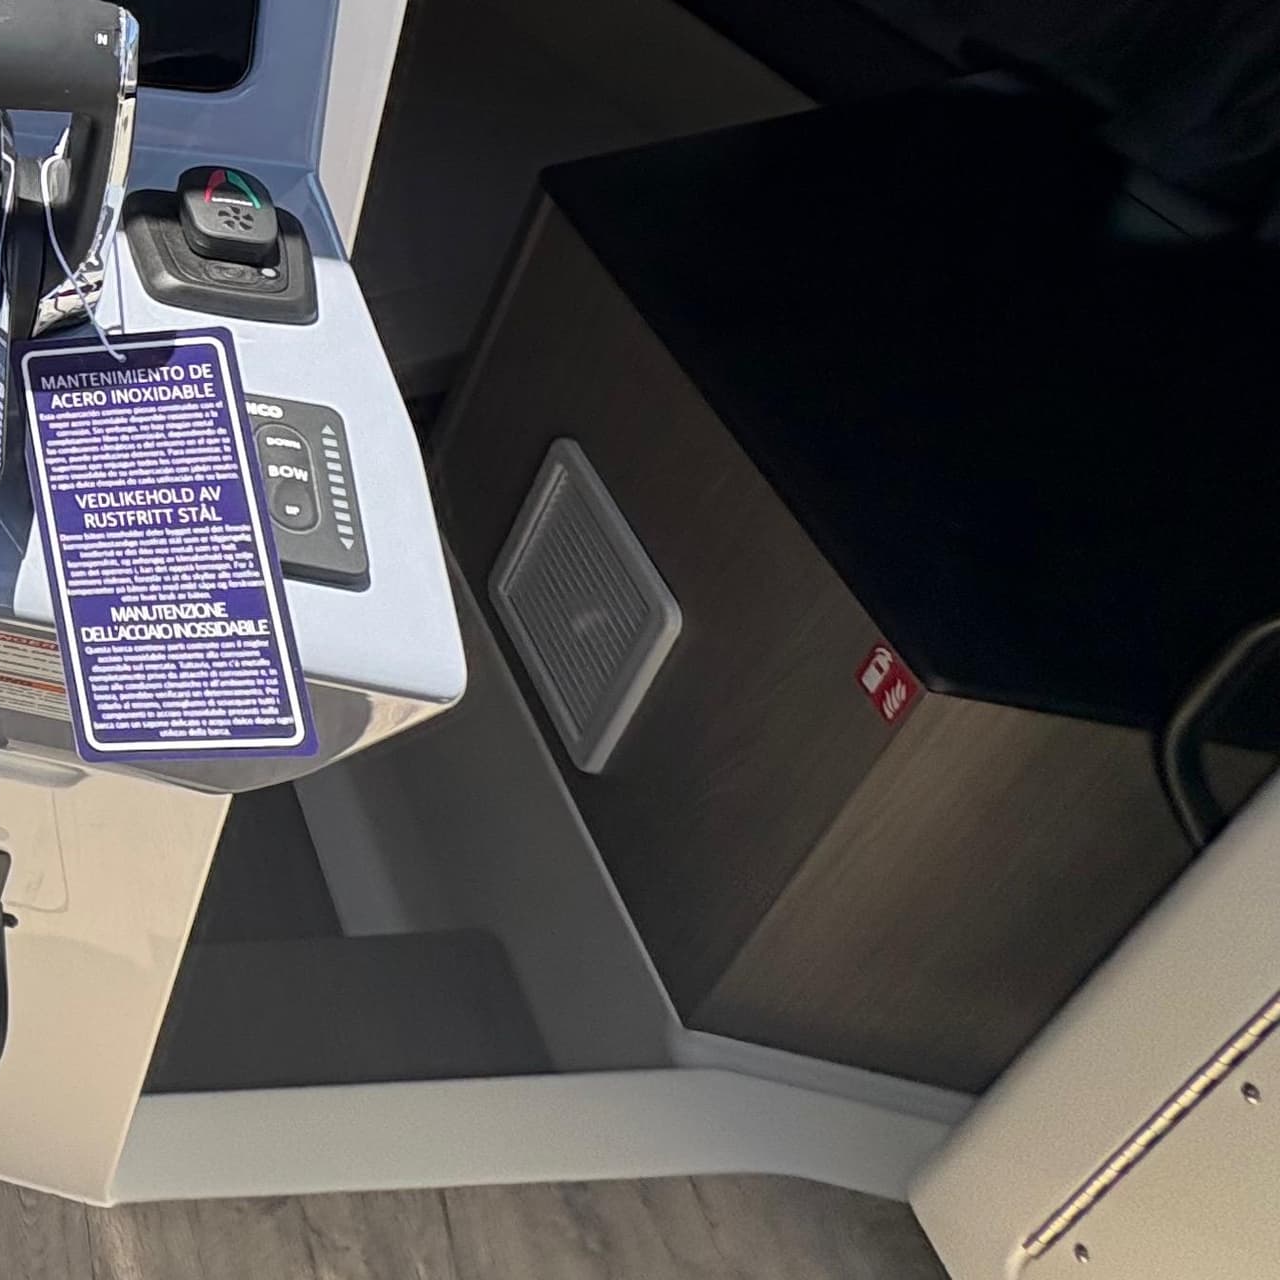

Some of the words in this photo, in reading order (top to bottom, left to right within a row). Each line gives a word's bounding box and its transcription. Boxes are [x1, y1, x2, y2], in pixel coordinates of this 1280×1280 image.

[96, 32, 108, 45] N
[41, 366, 184, 390] MANTENIMIENTO
[189, 363, 214, 380] DE
[51, 391, 107, 409] ACERO
[112, 383, 216, 405] INOXIDABLE
[265, 436, 302, 450] DOWN
[267, 464, 309, 482] BOW
[75, 487, 194, 509] VEDLIKEHOLD
[199, 486, 222, 501] AV
[83, 508, 174, 529] RUSTFRITT
[179, 504, 223, 523] STÅL
[285, 504, 301, 516] UP
[110, 602, 228, 623] MANUTENZIONE
[174, 619, 271, 639] INOSSIDABILE
